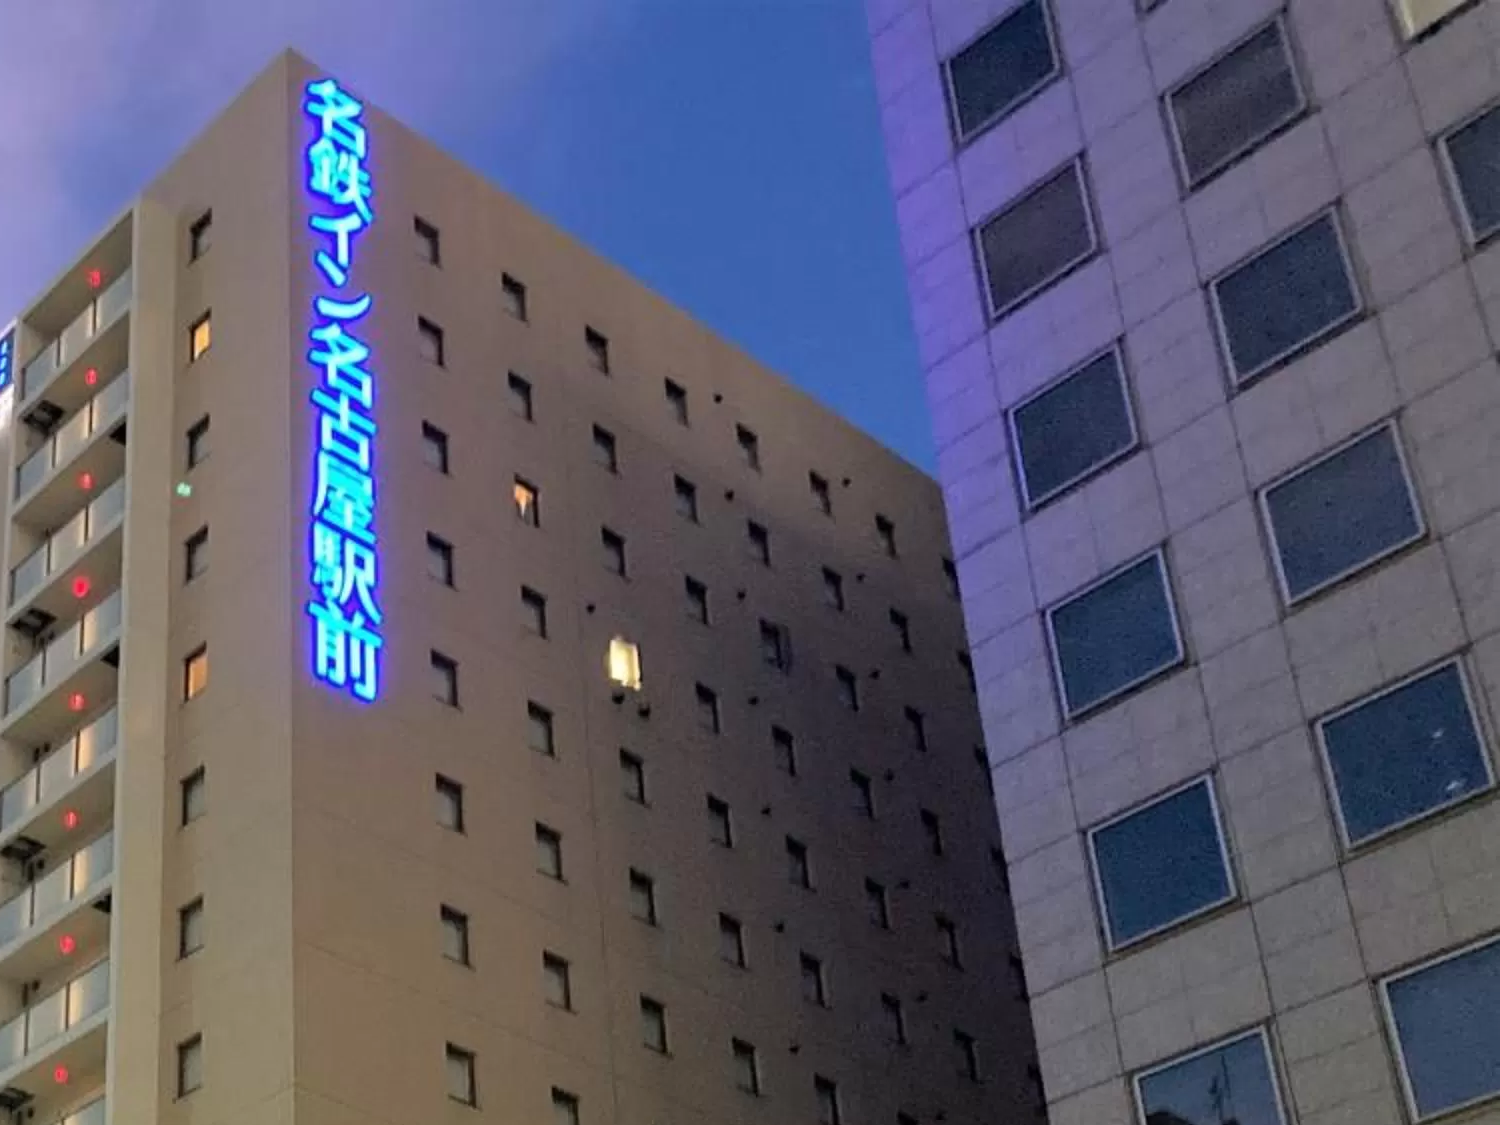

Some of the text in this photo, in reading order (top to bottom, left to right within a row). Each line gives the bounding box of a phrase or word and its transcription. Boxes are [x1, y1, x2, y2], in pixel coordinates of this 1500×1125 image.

[307, 79, 383, 702] 名鉄イン名古屋駅前
